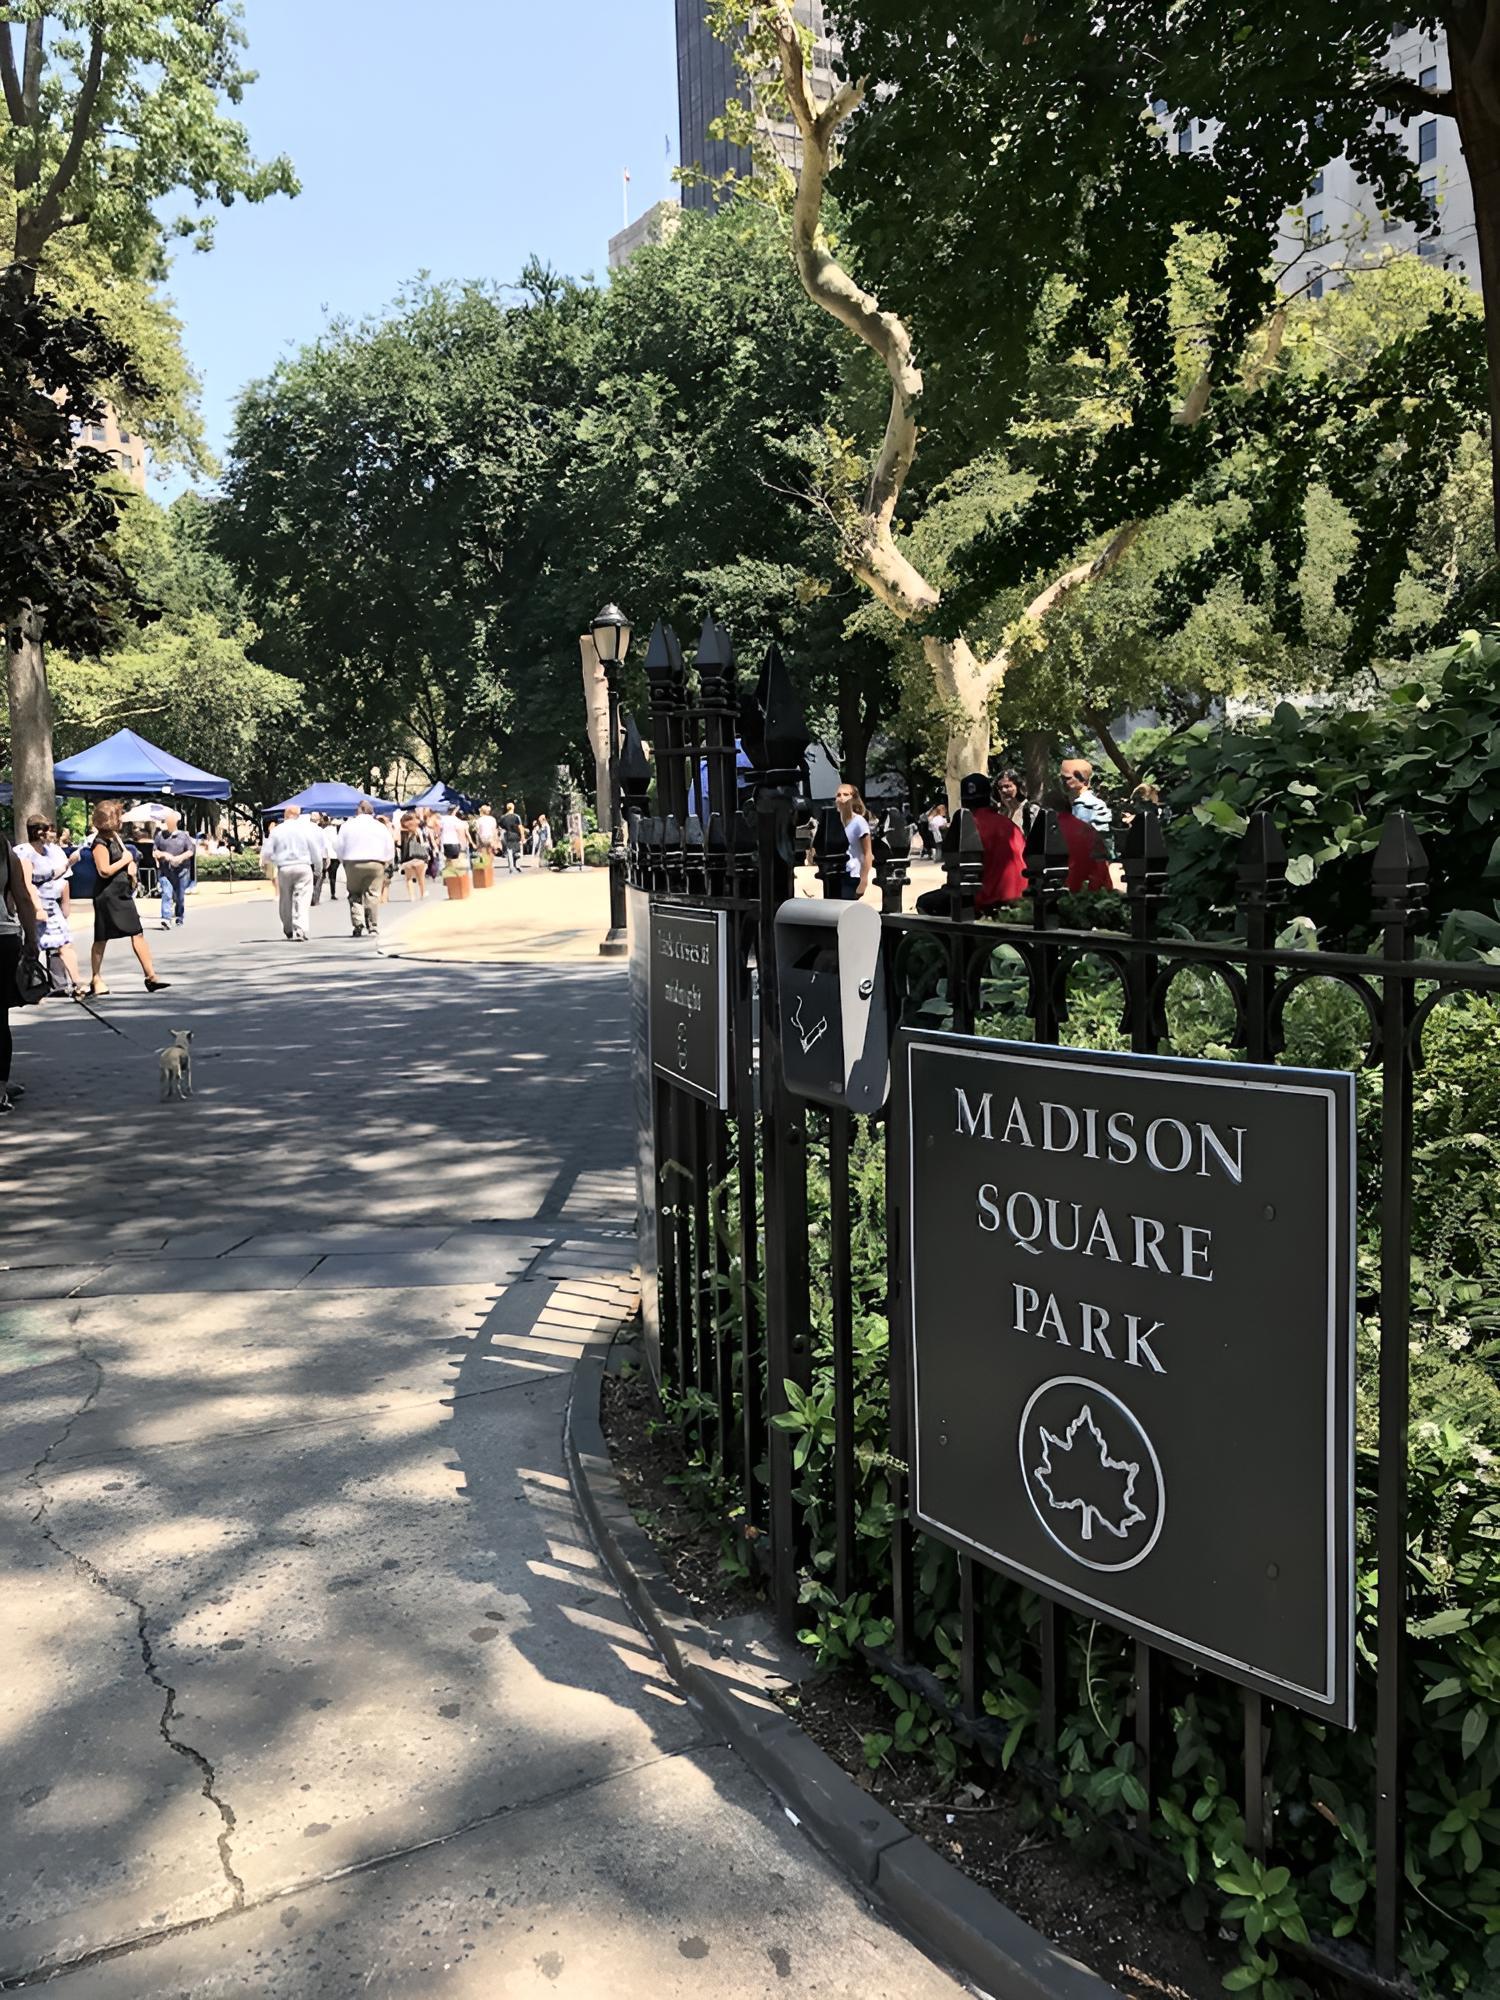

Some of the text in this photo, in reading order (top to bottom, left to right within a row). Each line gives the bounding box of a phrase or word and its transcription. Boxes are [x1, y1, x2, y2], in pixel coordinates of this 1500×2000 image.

[954, 1087, 1247, 1184] MADISON
[977, 1183, 1214, 1282] SQUARE
[1012, 1282, 1168, 1374] PARK
